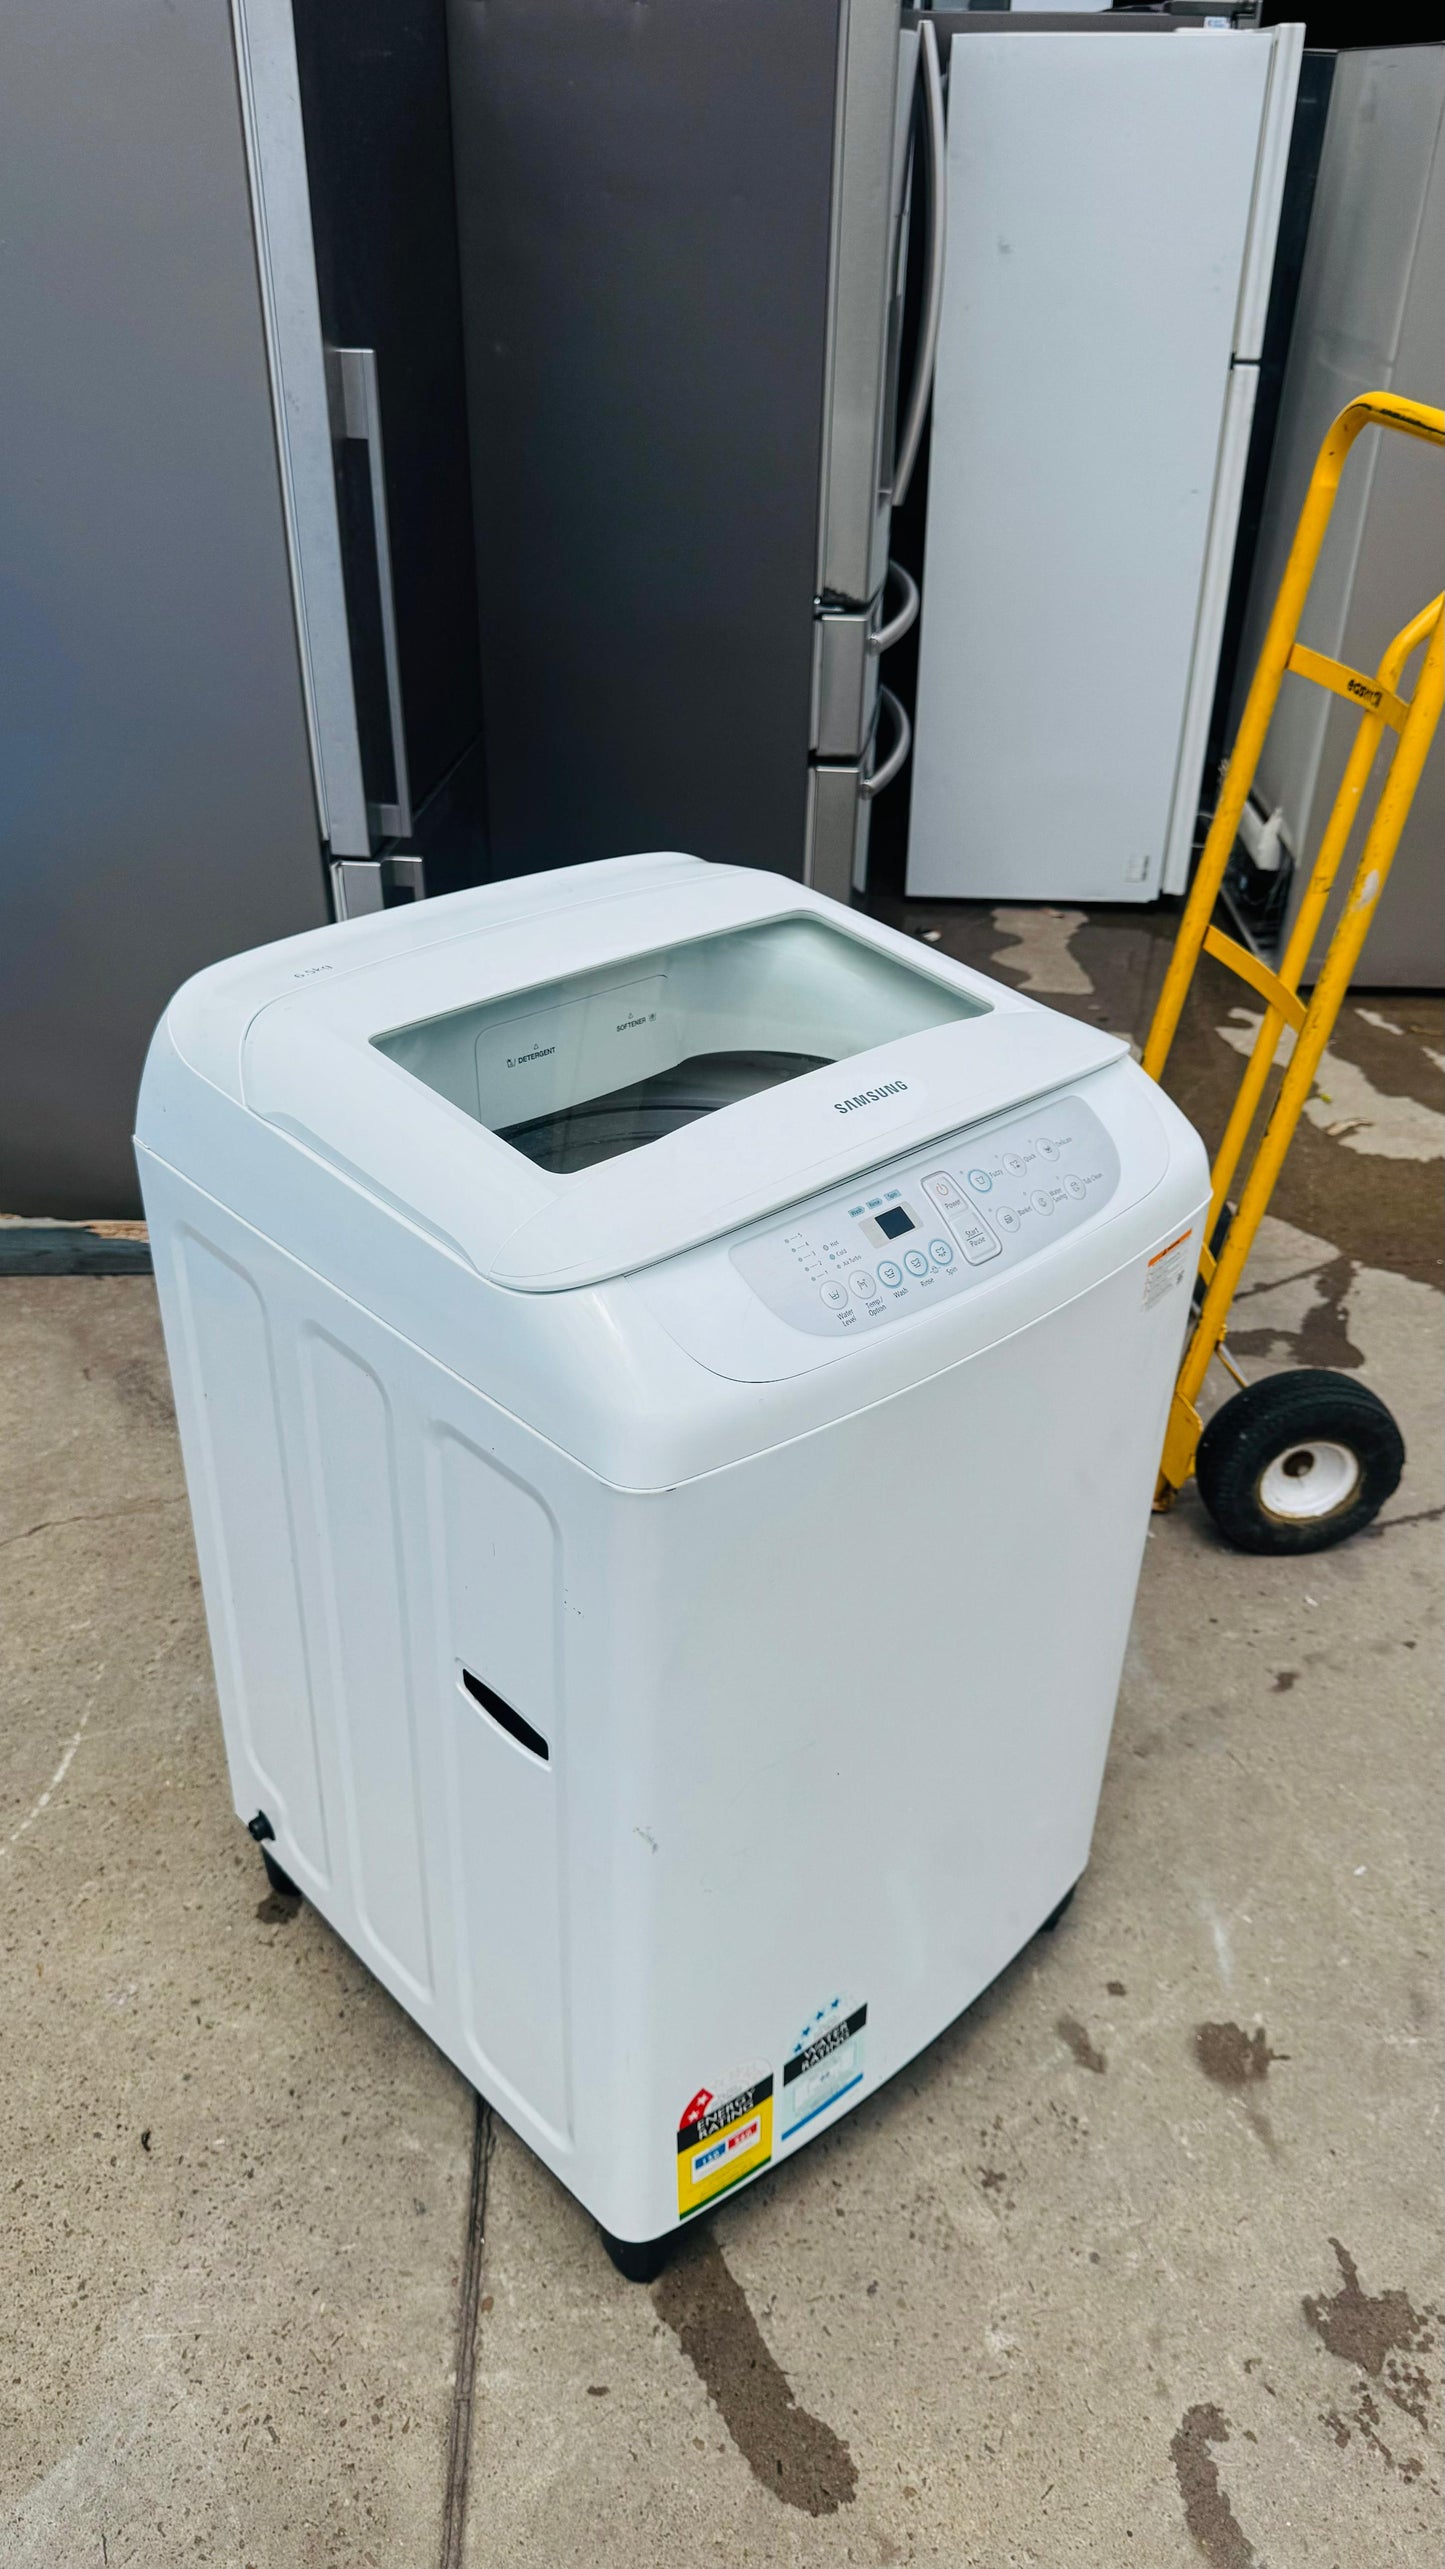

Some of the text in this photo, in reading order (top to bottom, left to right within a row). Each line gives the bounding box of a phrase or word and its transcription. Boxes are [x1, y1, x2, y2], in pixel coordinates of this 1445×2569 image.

[616, 1016, 647, 1032] SOFTENER
[517, 1047, 556, 1064] DETERGENT
[834, 1080, 908, 1114] SAMSUNG
[944, 1199, 961, 1210] Power
[965, 1227, 980, 1238] Start
[969, 1236, 986, 1247] Pause
[836, 1248, 848, 1257] Cold
[946, 1266, 958, 1276] Spin
[920, 1278, 935, 1288] Rinse
[893, 1287, 909, 1298] Wash
[836, 1308, 854, 1320] Water
[868, 1304, 887, 1317] Option
[842, 1315, 857, 1327] Level
[697, 2087, 755, 2131] ENERGY
[698, 2099, 754, 2141] RATING
